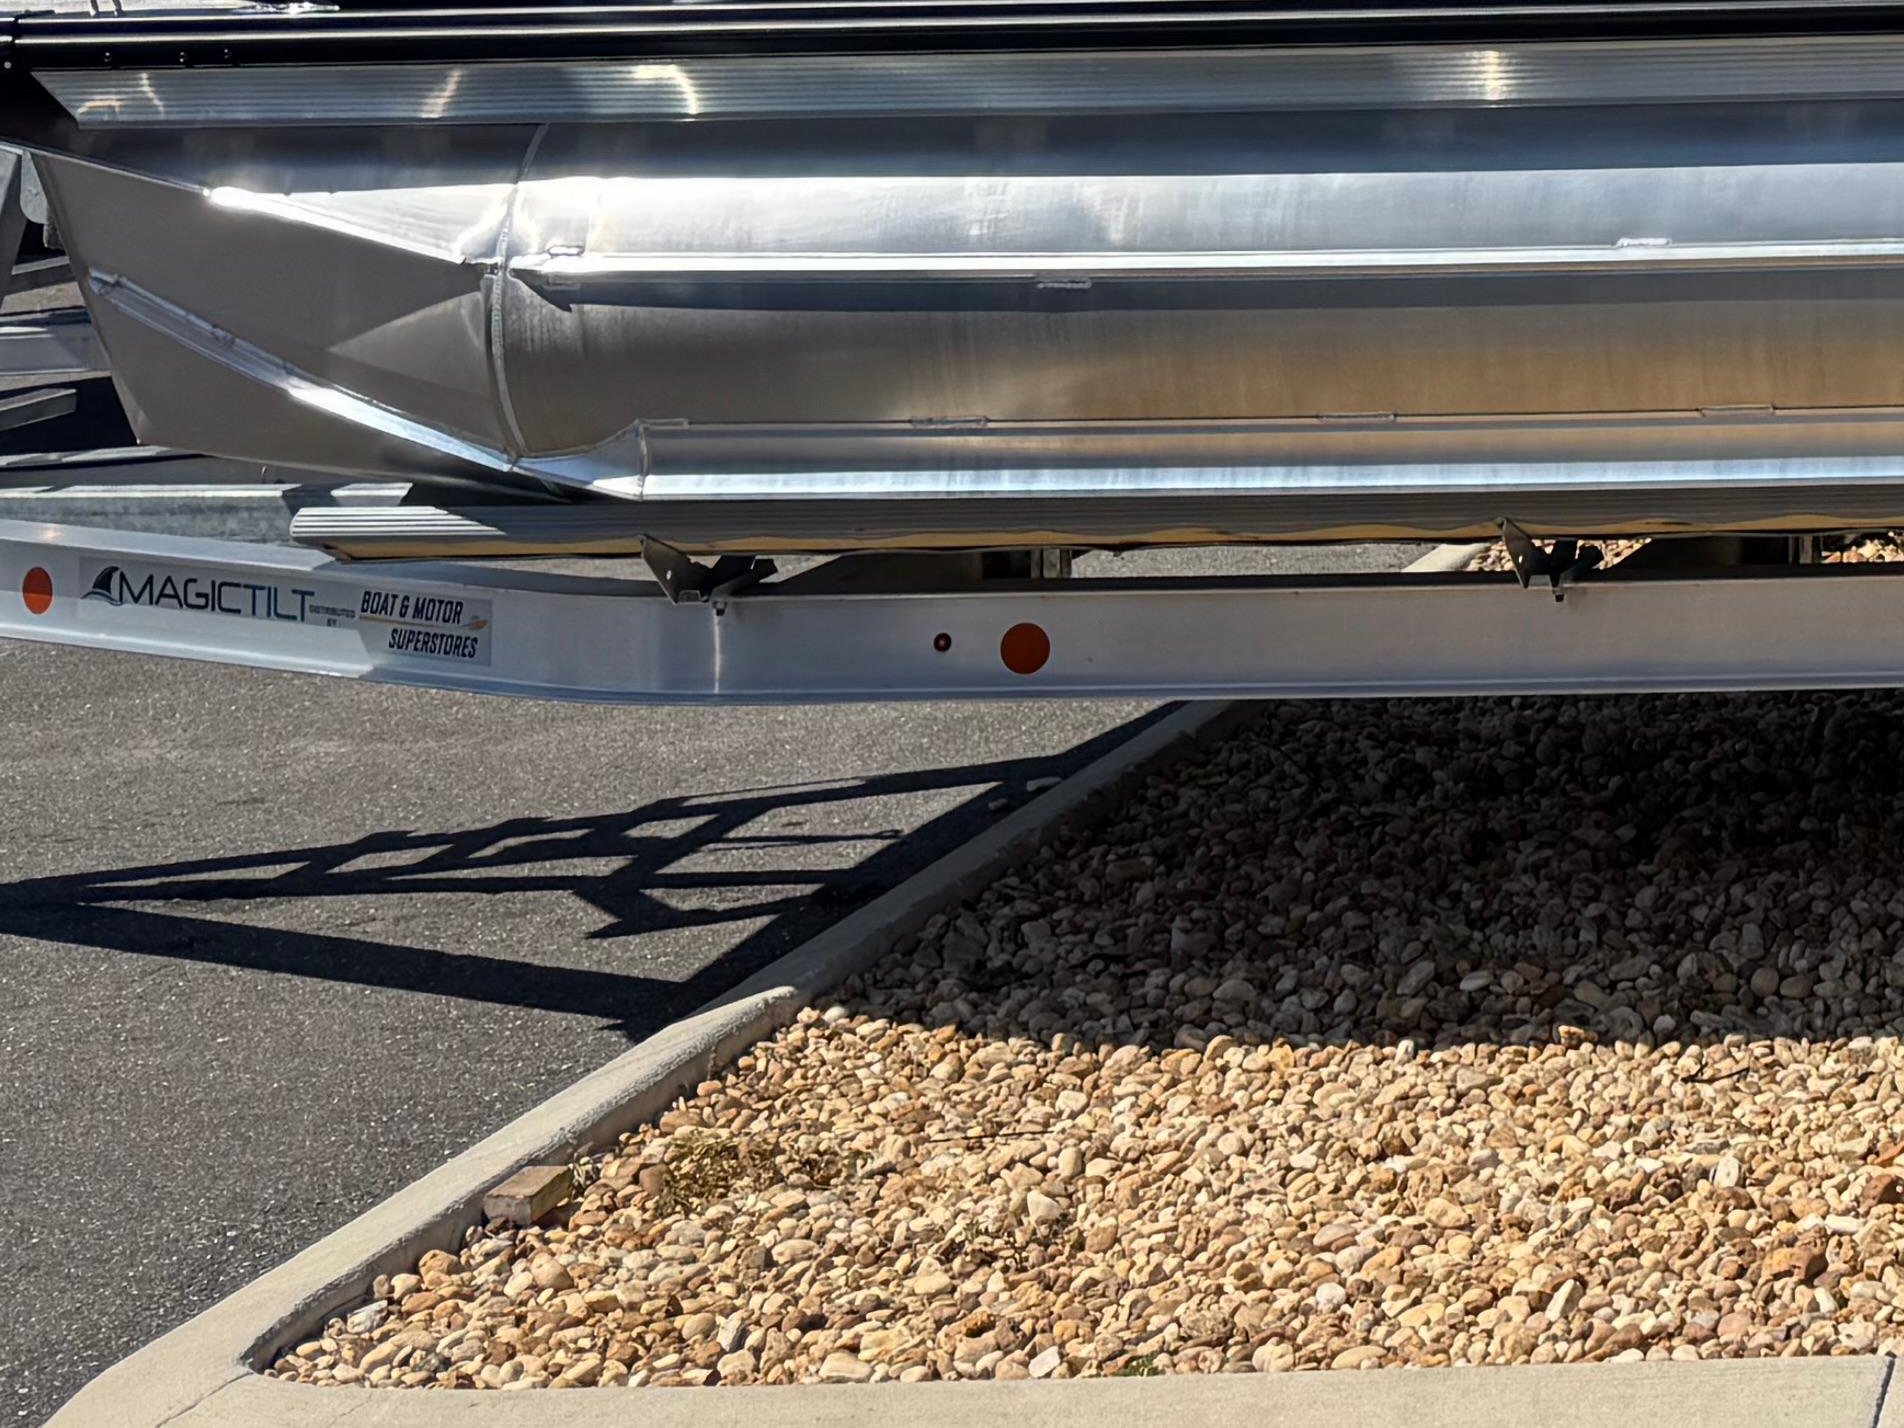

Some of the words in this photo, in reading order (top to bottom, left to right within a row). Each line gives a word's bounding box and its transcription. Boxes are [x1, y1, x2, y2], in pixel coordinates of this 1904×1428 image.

[118, 570, 315, 622] MAGICTILT
[360, 590, 399, 617] BOAT
[412, 597, 464, 625] MOTOR
[388, 628, 479, 659] SUPERSTORES
